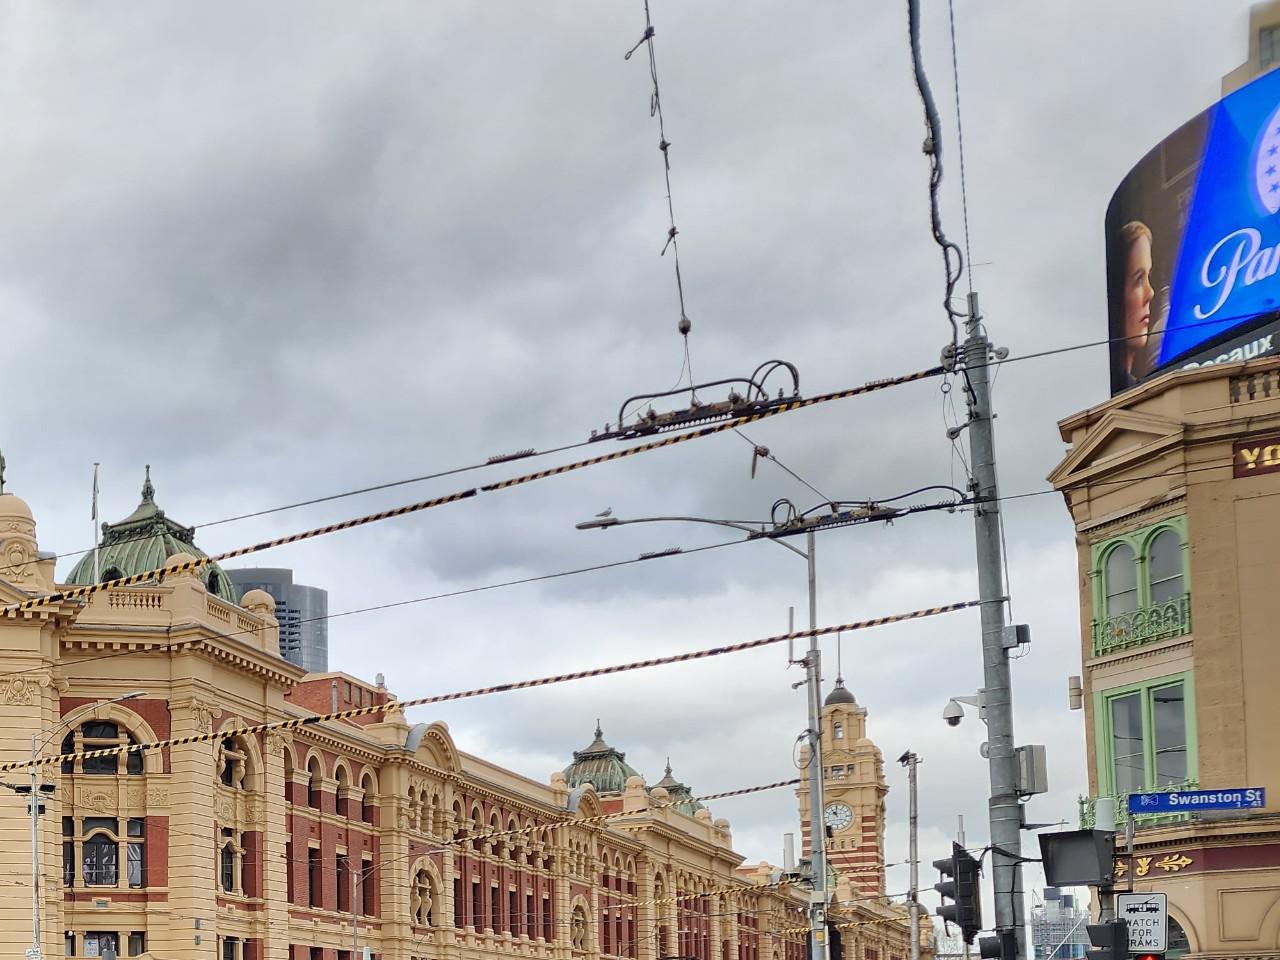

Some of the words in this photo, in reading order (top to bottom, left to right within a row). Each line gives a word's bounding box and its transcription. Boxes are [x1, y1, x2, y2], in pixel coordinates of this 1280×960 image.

[1169, 792, 1242, 805] Swanston
[1245, 789, 1262, 802] St
[1132, 928, 1153, 937] FOR
[1128, 939, 1159, 947] RAMS
